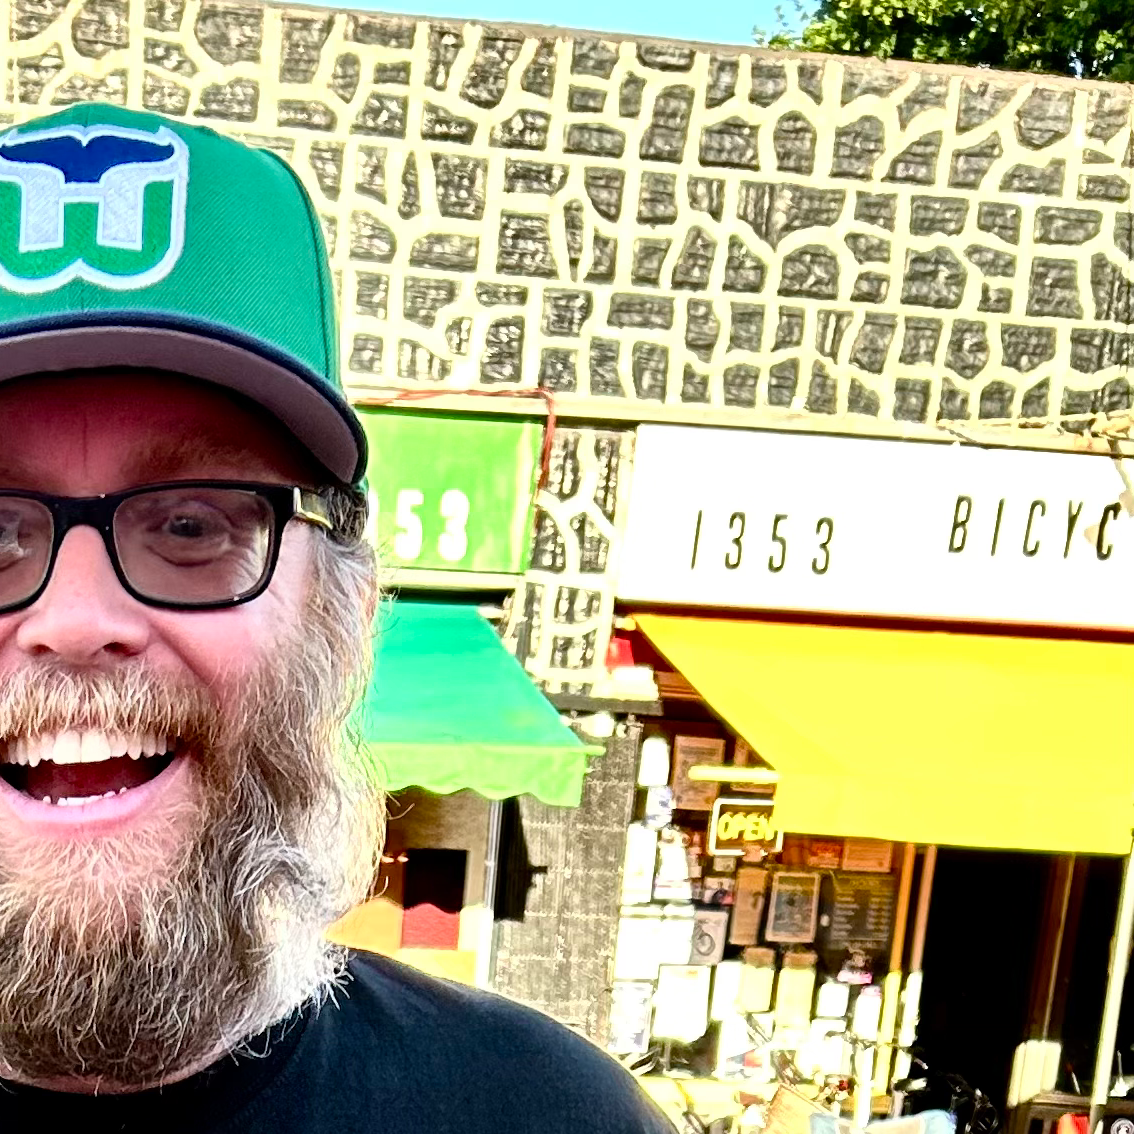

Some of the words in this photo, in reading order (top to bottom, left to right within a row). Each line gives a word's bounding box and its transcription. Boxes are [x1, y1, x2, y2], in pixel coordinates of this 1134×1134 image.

[690, 510, 834, 575] 1353
[948, 495, 1122, 561] BICYC
[718, 811, 775, 841] OPEN
